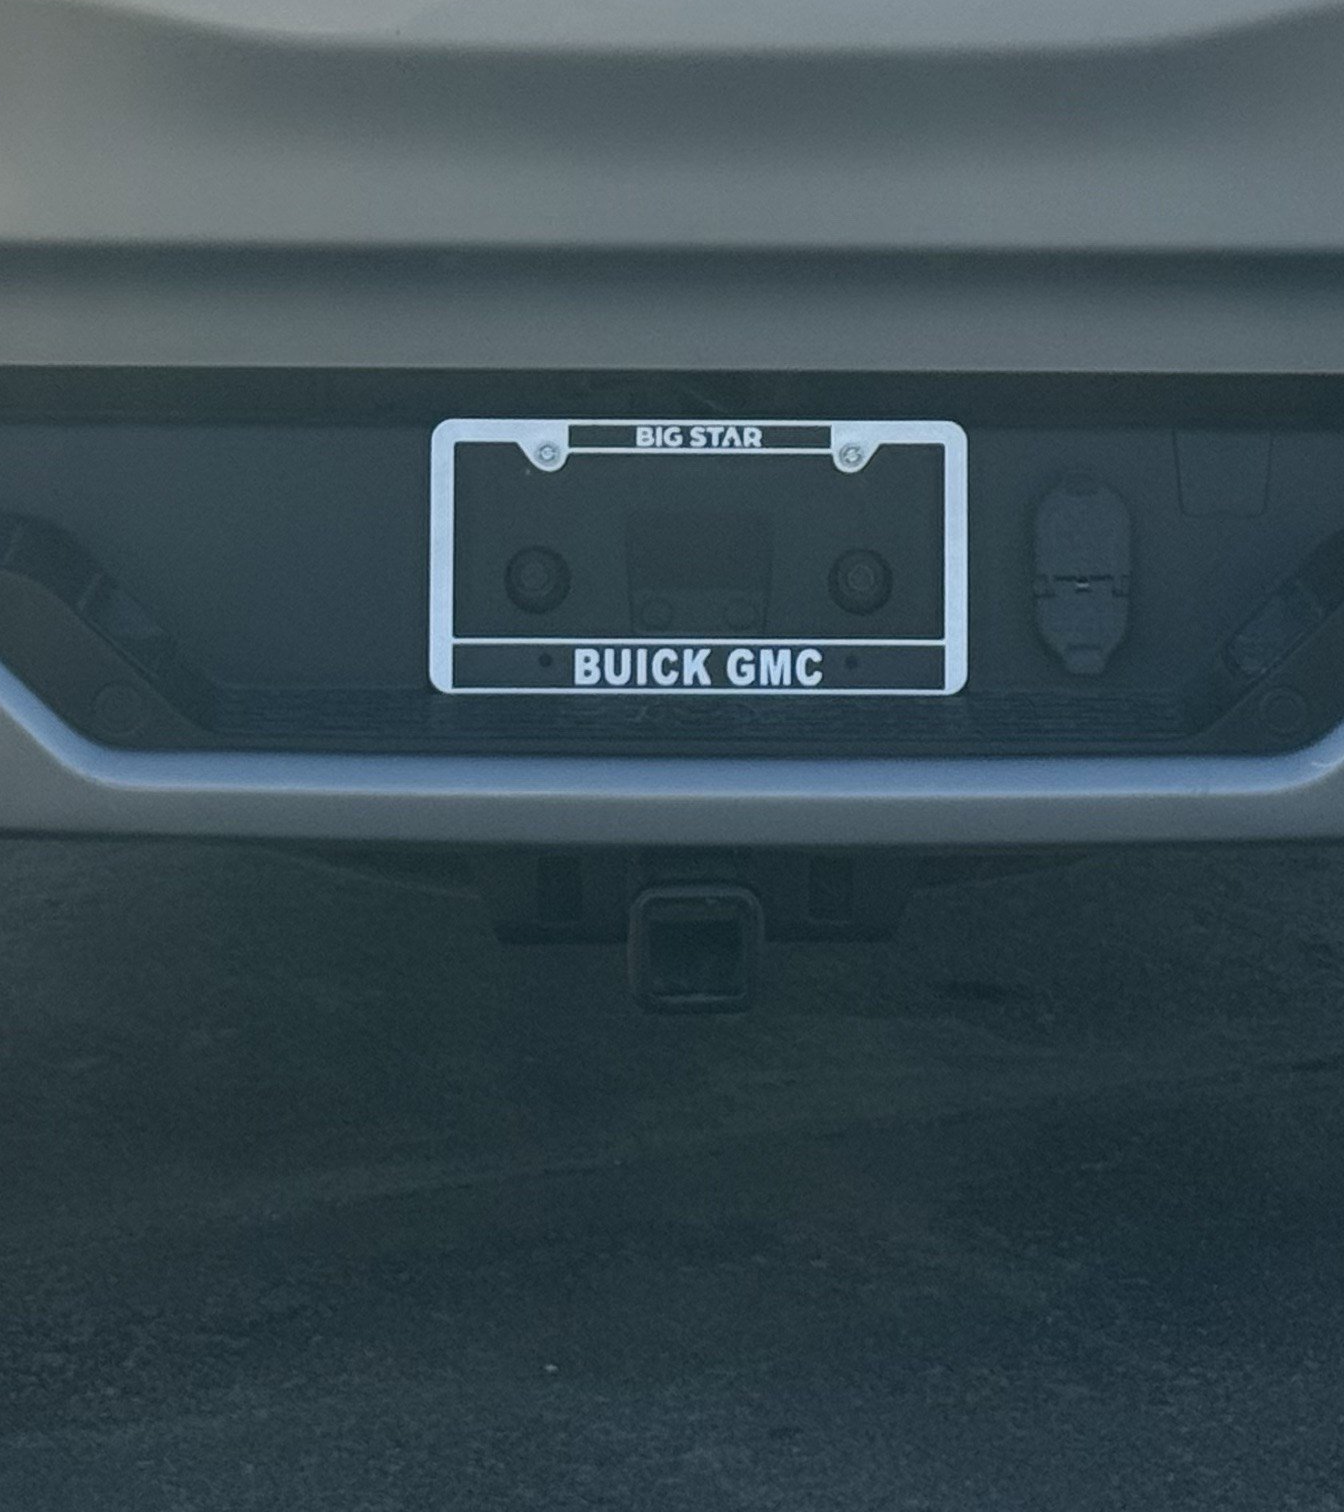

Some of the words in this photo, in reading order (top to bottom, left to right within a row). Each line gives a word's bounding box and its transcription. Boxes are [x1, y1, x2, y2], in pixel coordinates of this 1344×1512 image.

[636, 426, 683, 448] BIG
[689, 426, 763, 448] STAR
[574, 648, 712, 686] BUICK
[726, 649, 823, 687] GMC
